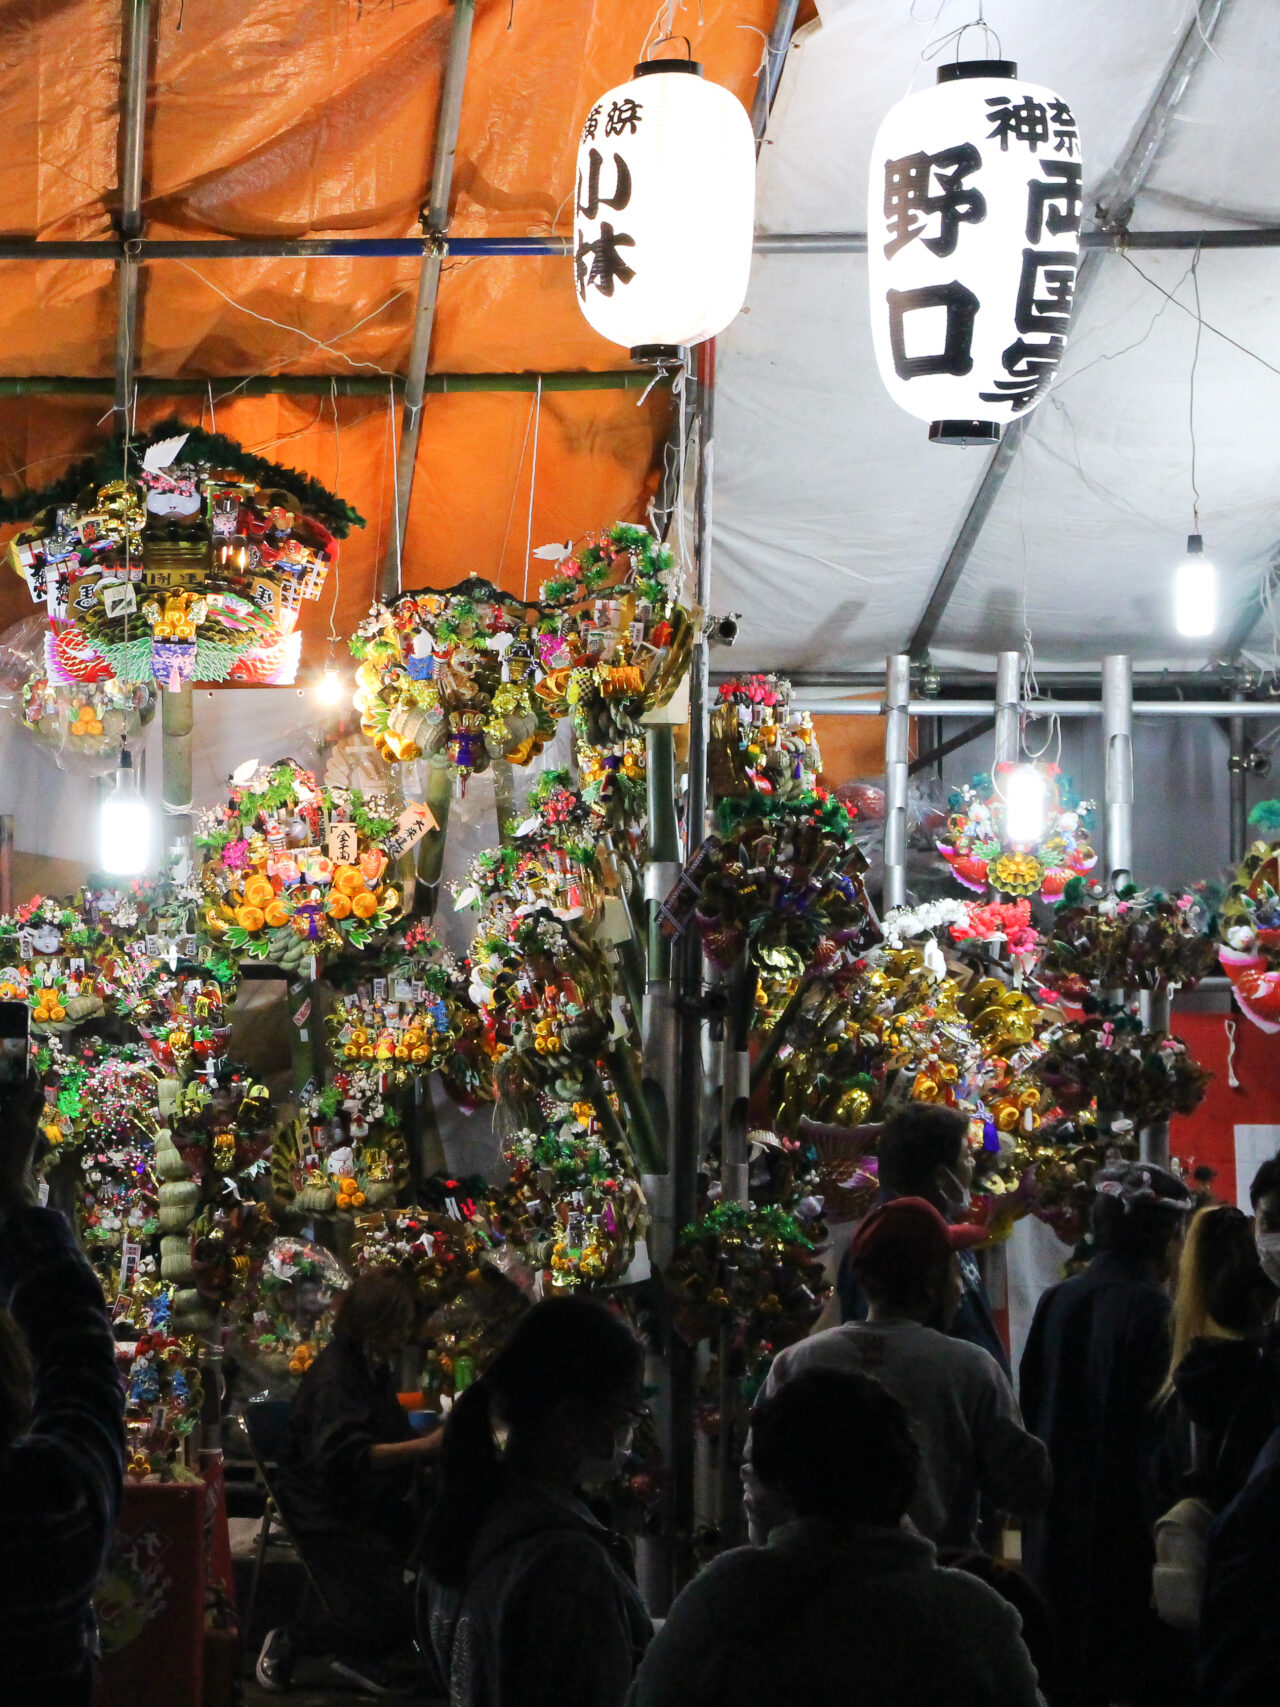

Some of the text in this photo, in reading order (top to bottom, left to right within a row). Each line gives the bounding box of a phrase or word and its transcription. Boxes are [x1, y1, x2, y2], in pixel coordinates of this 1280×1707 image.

[883, 142, 988, 381] 野口
[336, 829, 351, 861] 金千両
